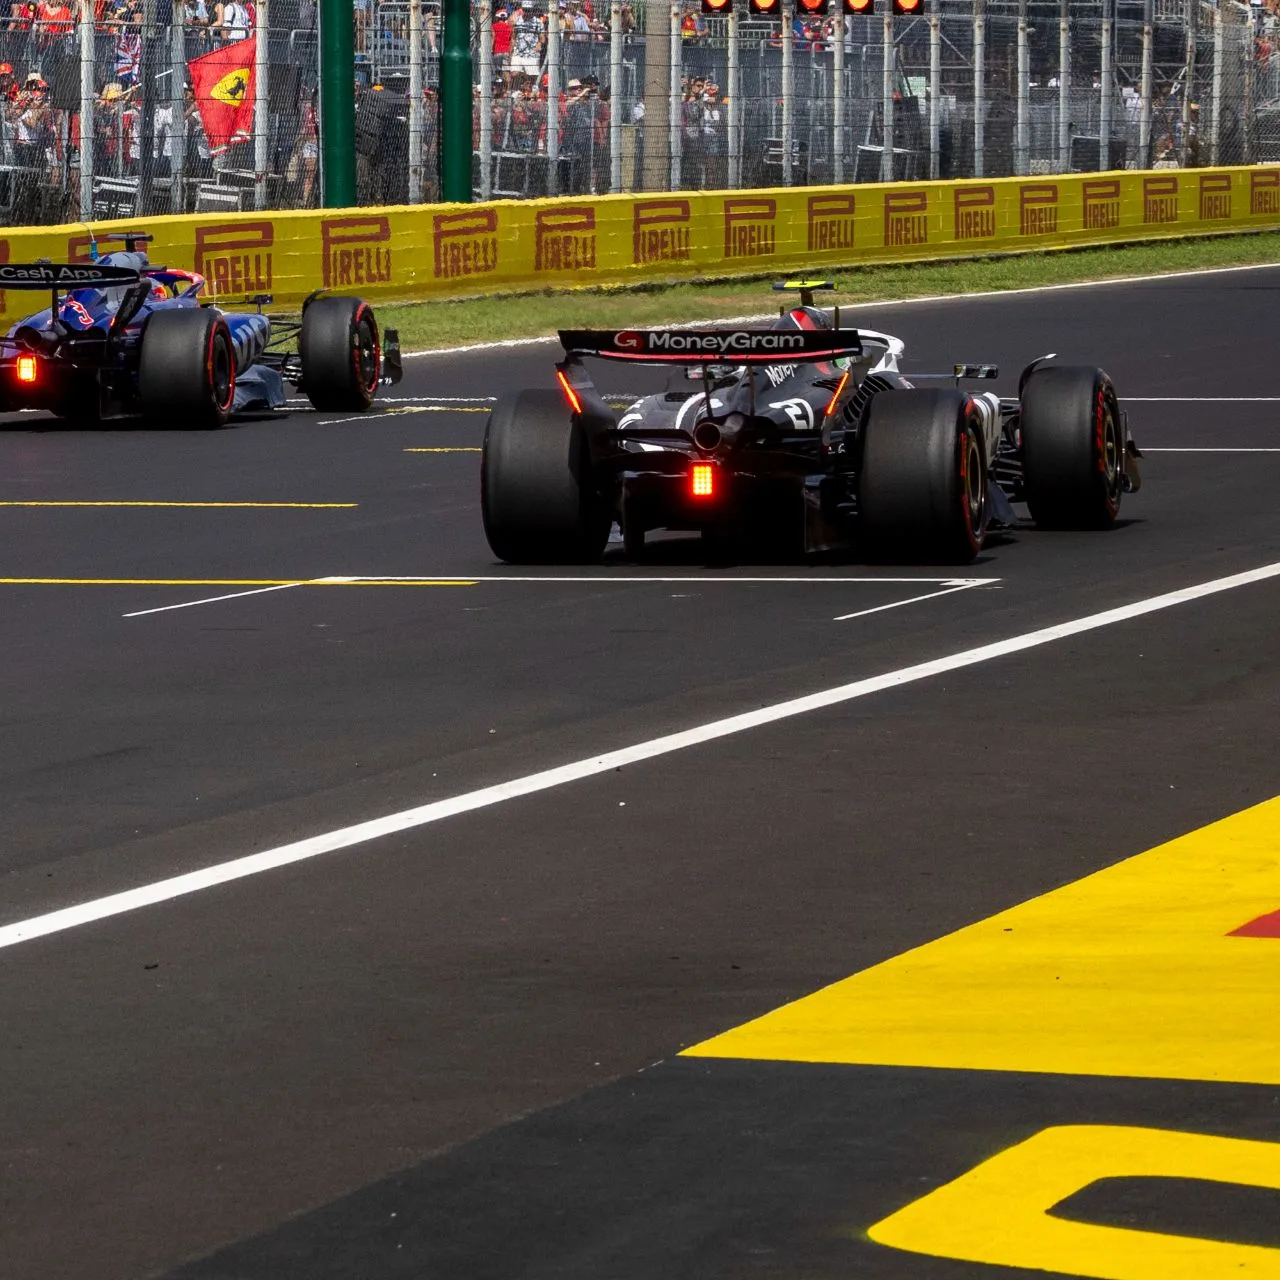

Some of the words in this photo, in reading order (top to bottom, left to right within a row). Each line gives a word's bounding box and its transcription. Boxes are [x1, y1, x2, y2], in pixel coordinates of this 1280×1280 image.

[808, 195, 855, 251] PIRELLI
[884, 191, 928, 246] PIRELLI
[954, 187, 996, 239] PIRELLI
[1020, 185, 1058, 235] PIRELLI
[1083, 181, 1121, 229] PIRELLI
[1144, 177, 1178, 223] PIRELLI
[1199, 174, 1232, 220] PIRELLI
[322, 218, 391, 288] PIRELLI
[433, 210, 498, 278] PIRELLI
[535, 208, 596, 273] PIRELLI
[634, 201, 691, 265] PIRELLI
[724, 199, 777, 257] PIRELLI
[0, 267, 55, 280] Cash
[58, 268, 103, 280] App
[648, 332, 805, 352] MoneyGram
